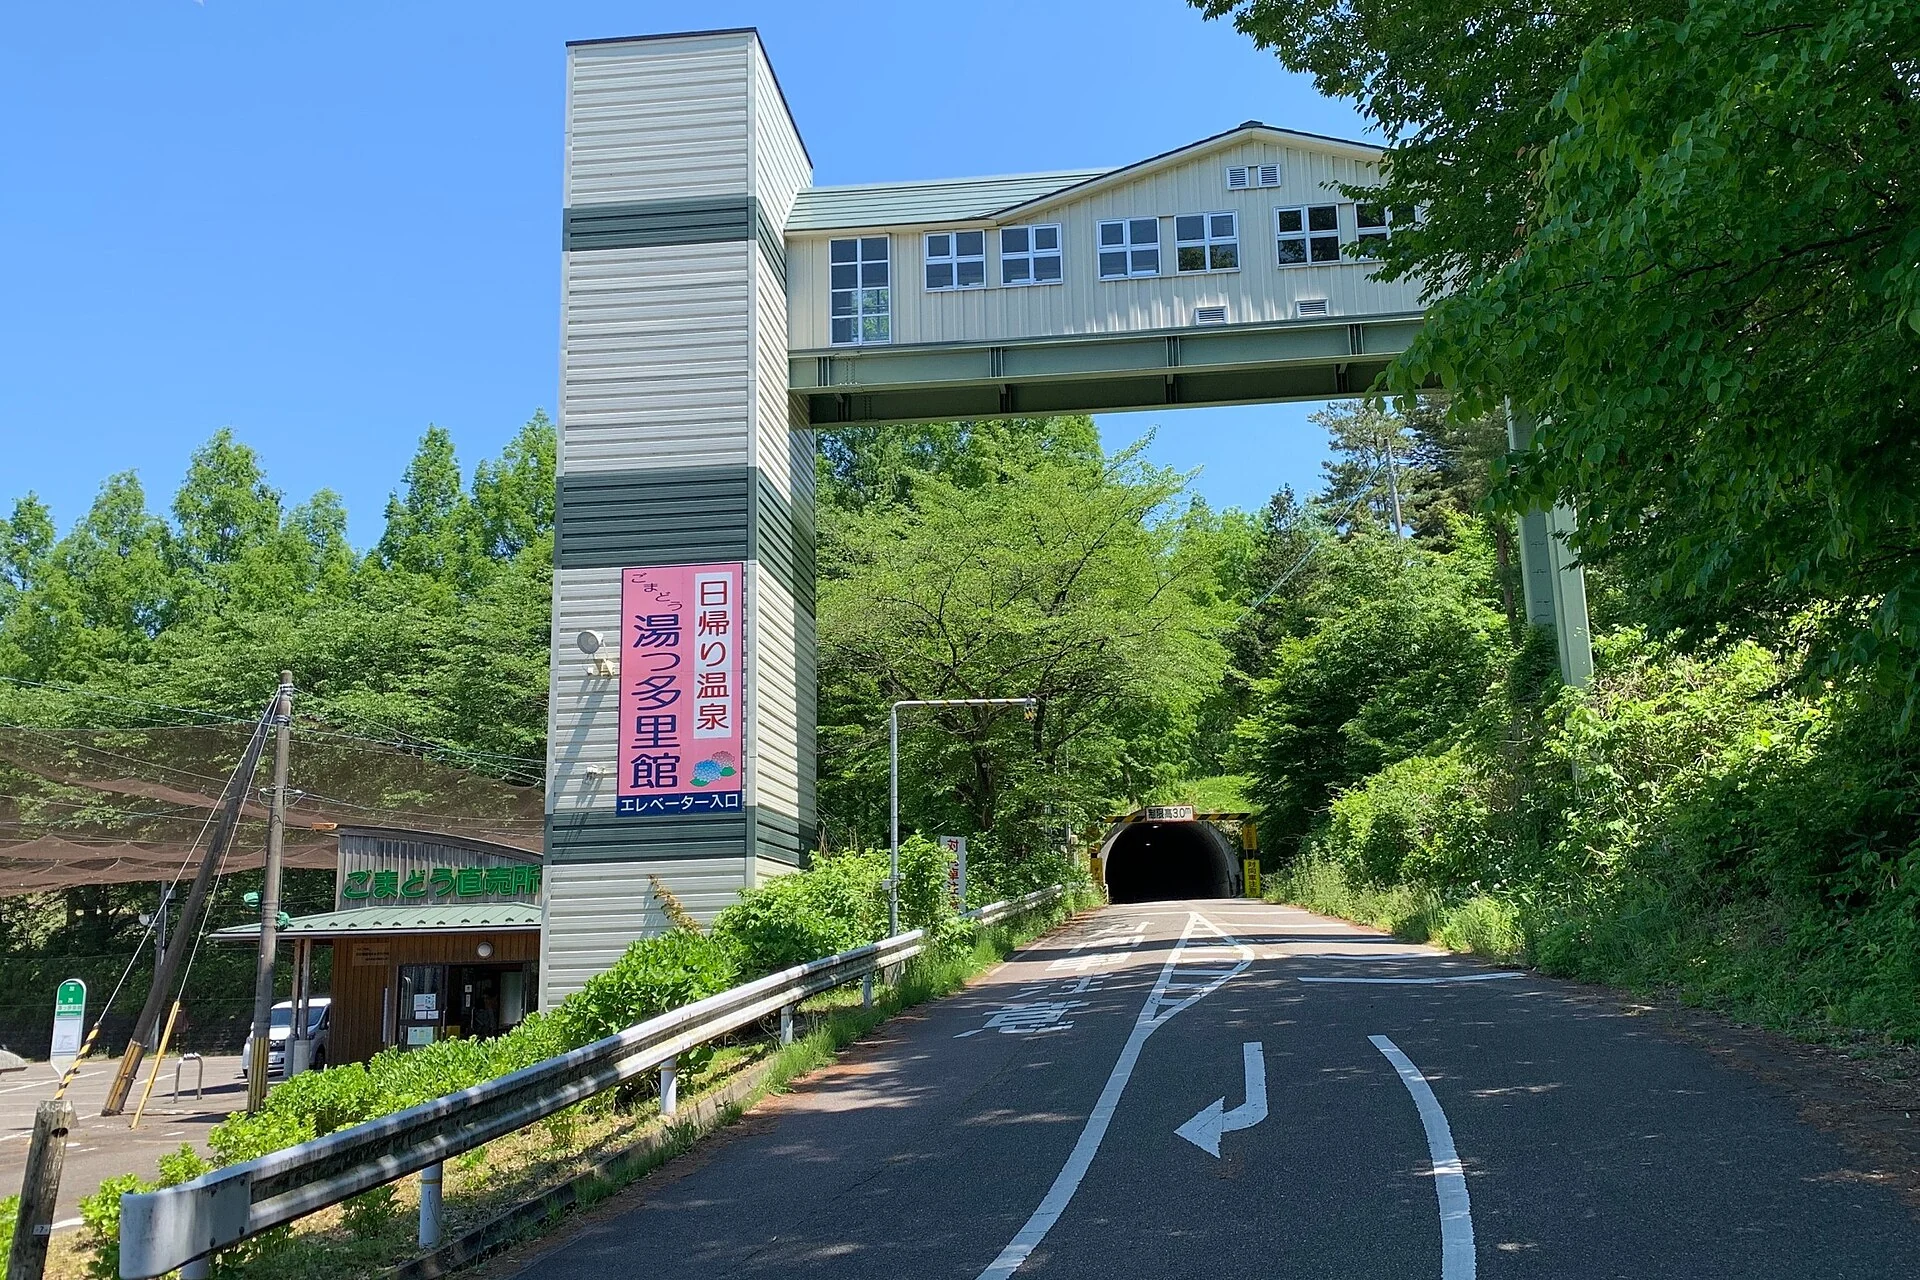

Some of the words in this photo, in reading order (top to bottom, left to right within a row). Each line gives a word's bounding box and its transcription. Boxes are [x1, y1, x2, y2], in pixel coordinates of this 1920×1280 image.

[631, 572, 683, 611] ごまどう
[696, 580, 730, 730] 日帰り温泉
[620, 793, 738, 812] エレベーター入口
[343, 864, 542, 899] ごまどう直売所
